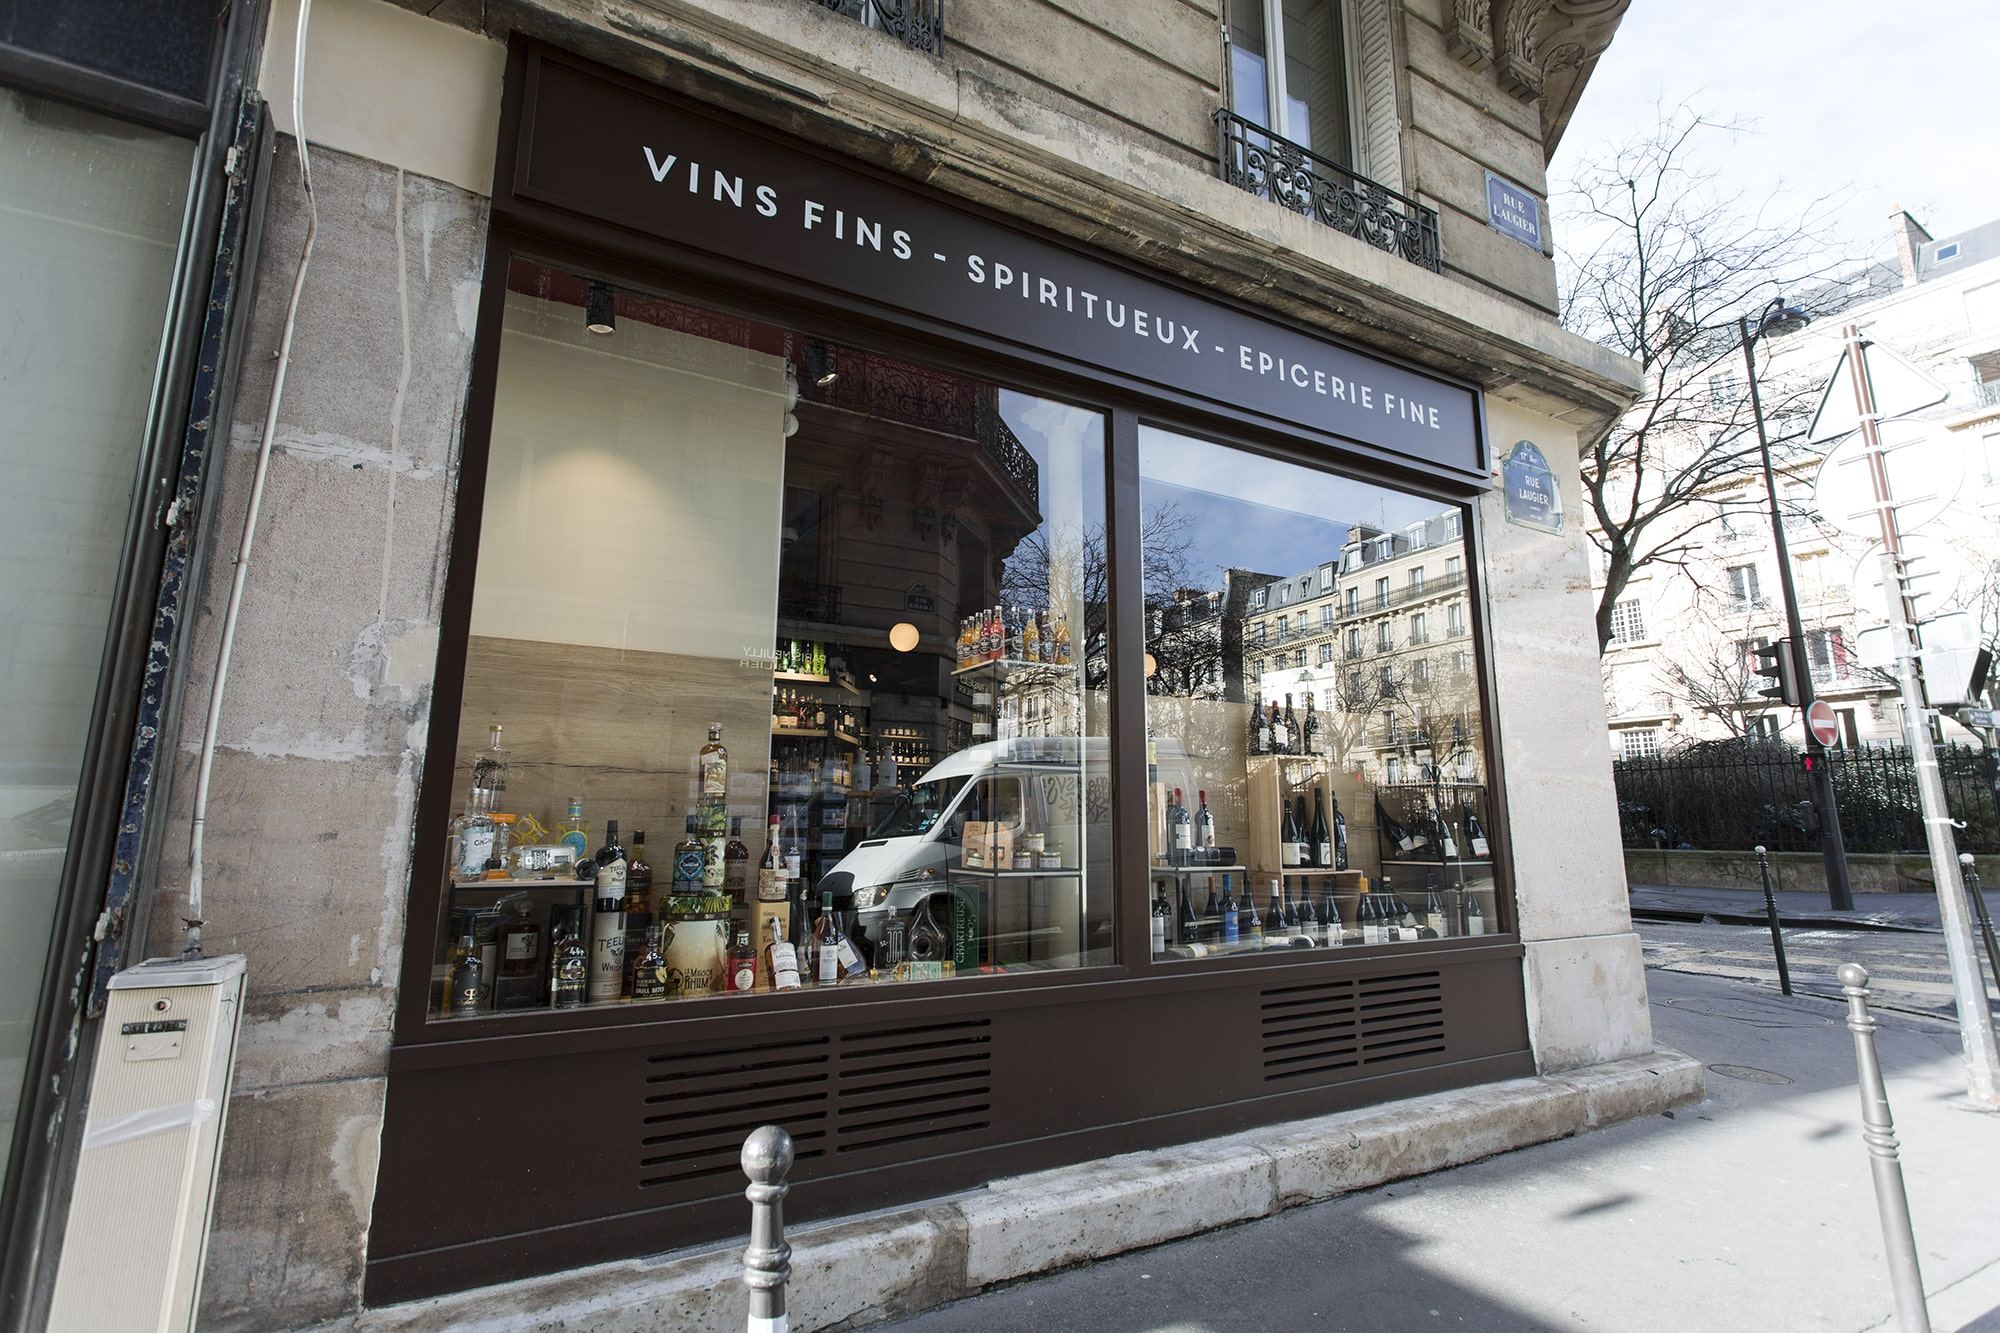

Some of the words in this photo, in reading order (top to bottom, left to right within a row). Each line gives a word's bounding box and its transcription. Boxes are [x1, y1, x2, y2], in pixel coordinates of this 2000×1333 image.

[1503, 193, 1525, 213] RUE
[1493, 203, 1537, 236] LAUGIER
[643, 146, 778, 217] VINS
[804, 199, 912, 260] FINS
[967, 254, 1200, 354] SPIRITUEUX
[1239, 344, 1374, 410] EPICERIE
[1384, 392, 1441, 430] FINE
[1525, 475, 1540, 489] RUE
[1518, 488, 1549, 506] LAUGIER
[955, 898, 965, 963] CHARTREUSE
[886, 930, 903, 964] 303
[684, 975, 710, 989] RHUM
